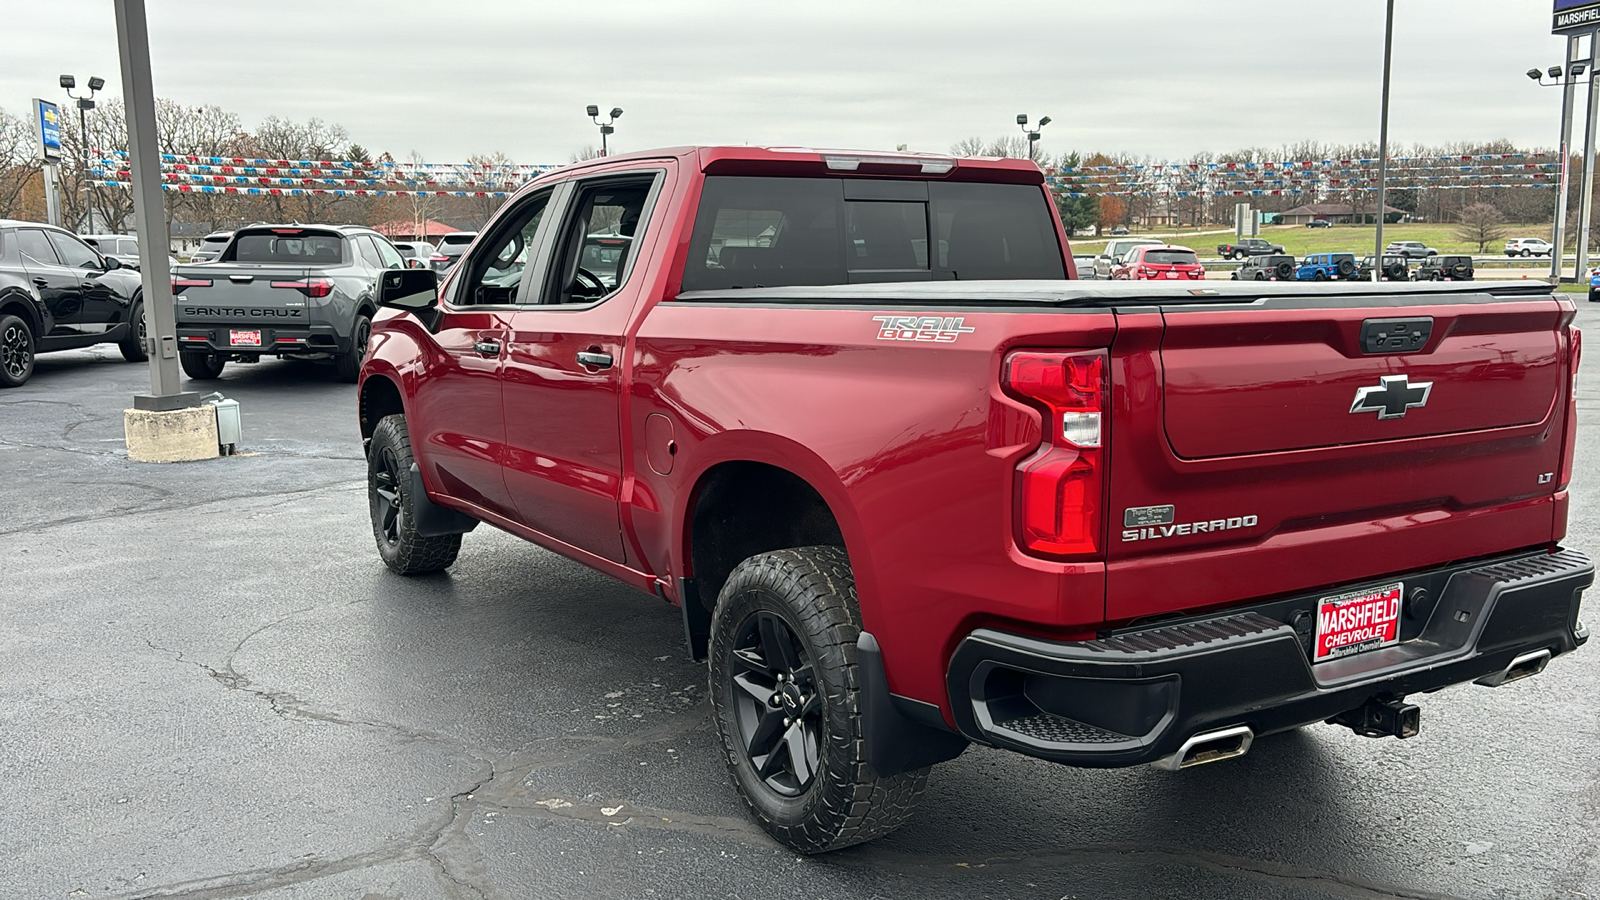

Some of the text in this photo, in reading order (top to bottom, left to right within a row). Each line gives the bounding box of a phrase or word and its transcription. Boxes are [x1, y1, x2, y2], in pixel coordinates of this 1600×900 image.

[184, 307, 302, 318] SANTA CRUZ
[872, 315, 976, 333] TRAIL
[877, 329, 959, 343] BOSS
[1538, 472, 1554, 484] LT
[1121, 515, 1258, 542] SILVERADO
[1319, 598, 1399, 635] MARSHFIELD
[1325, 623, 1389, 648] CHEVROLET
